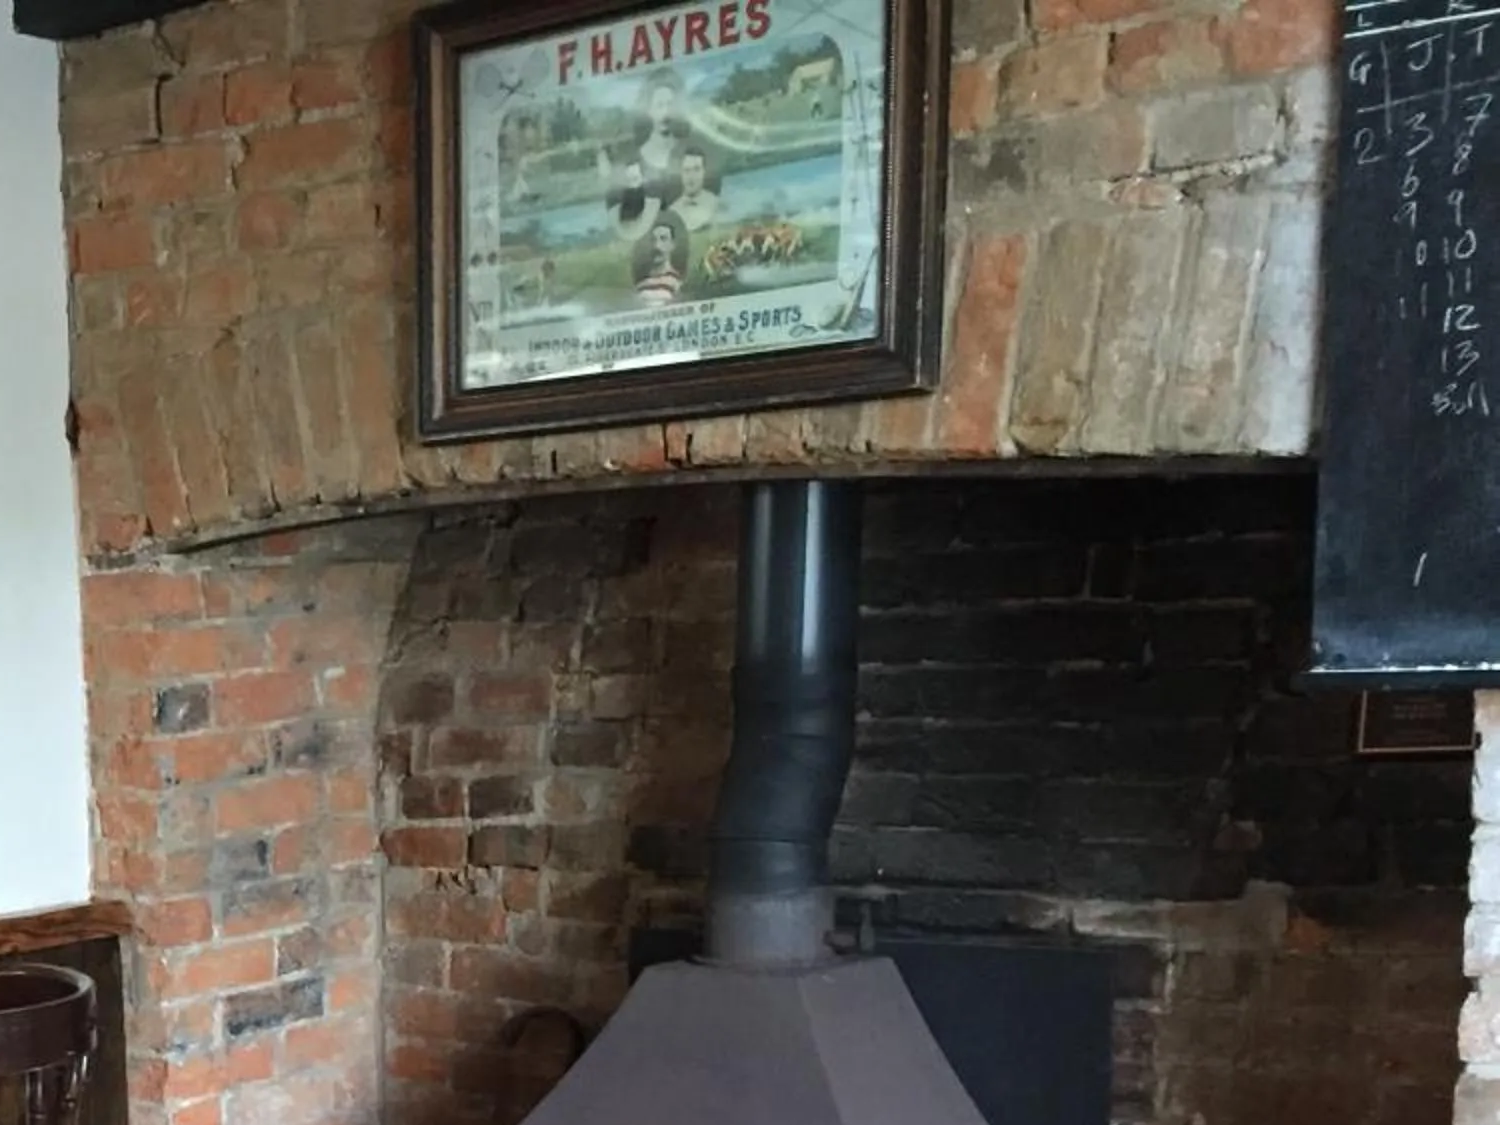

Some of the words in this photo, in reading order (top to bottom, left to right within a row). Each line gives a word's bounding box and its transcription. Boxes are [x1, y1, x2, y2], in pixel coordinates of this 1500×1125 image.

[1354, 128, 1385, 165] 2
[1404, 112, 1434, 156] 3
[1465, 93, 1493, 137] 7
[1402, 160, 1419, 197] 6
[1452, 144, 1472, 175] 8
[1448, 189, 1464, 226] 9
[1443, 229, 1476, 264] 10
[667, 315, 721, 341] GAMES
[739, 305, 802, 330] SPORTS
[1443, 304, 1481, 334] 12
[1441, 340, 1480, 376] 13
